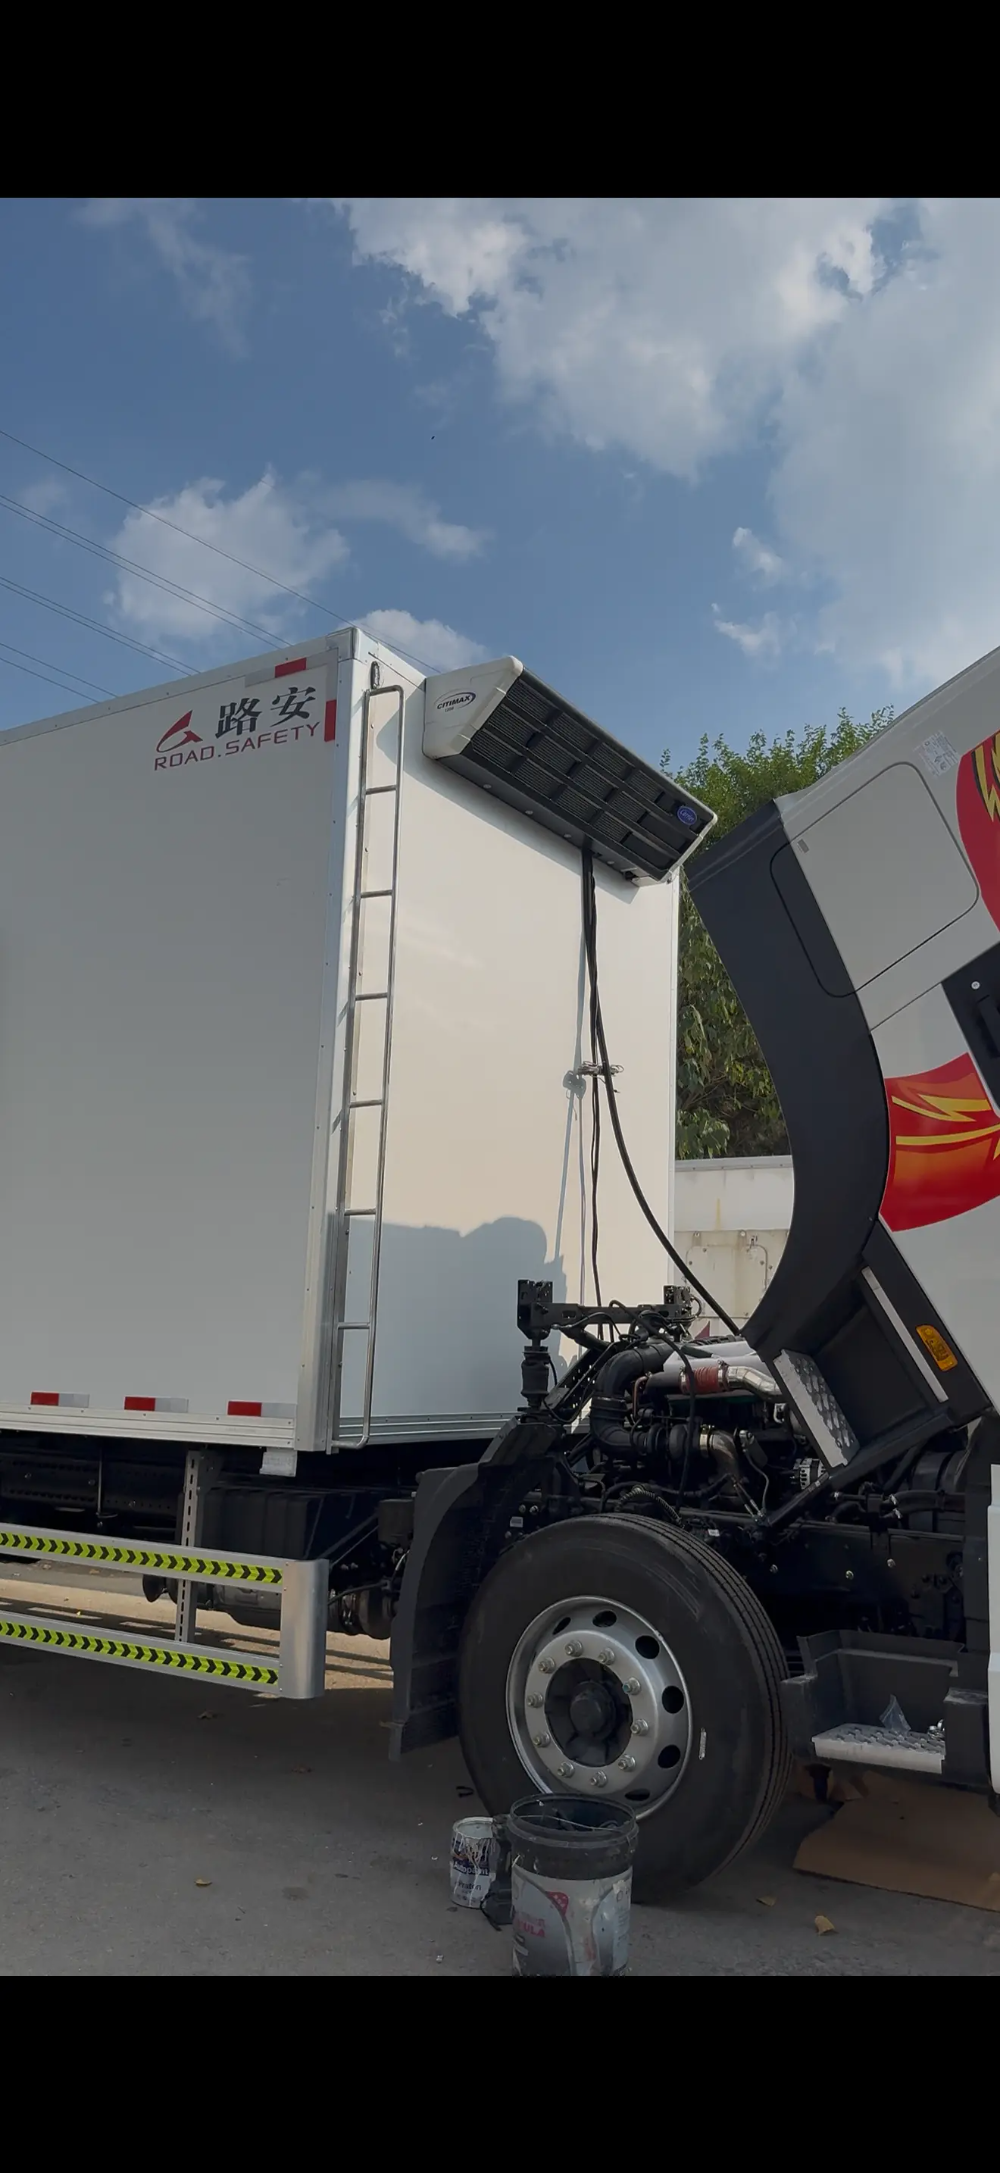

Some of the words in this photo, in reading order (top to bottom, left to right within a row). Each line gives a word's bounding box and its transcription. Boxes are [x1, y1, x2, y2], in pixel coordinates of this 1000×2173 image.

[215, 686, 316, 739] 路安
[437, 695, 470, 709] CITIMAX
[154, 721, 320, 771] ROAD.SAFETY
